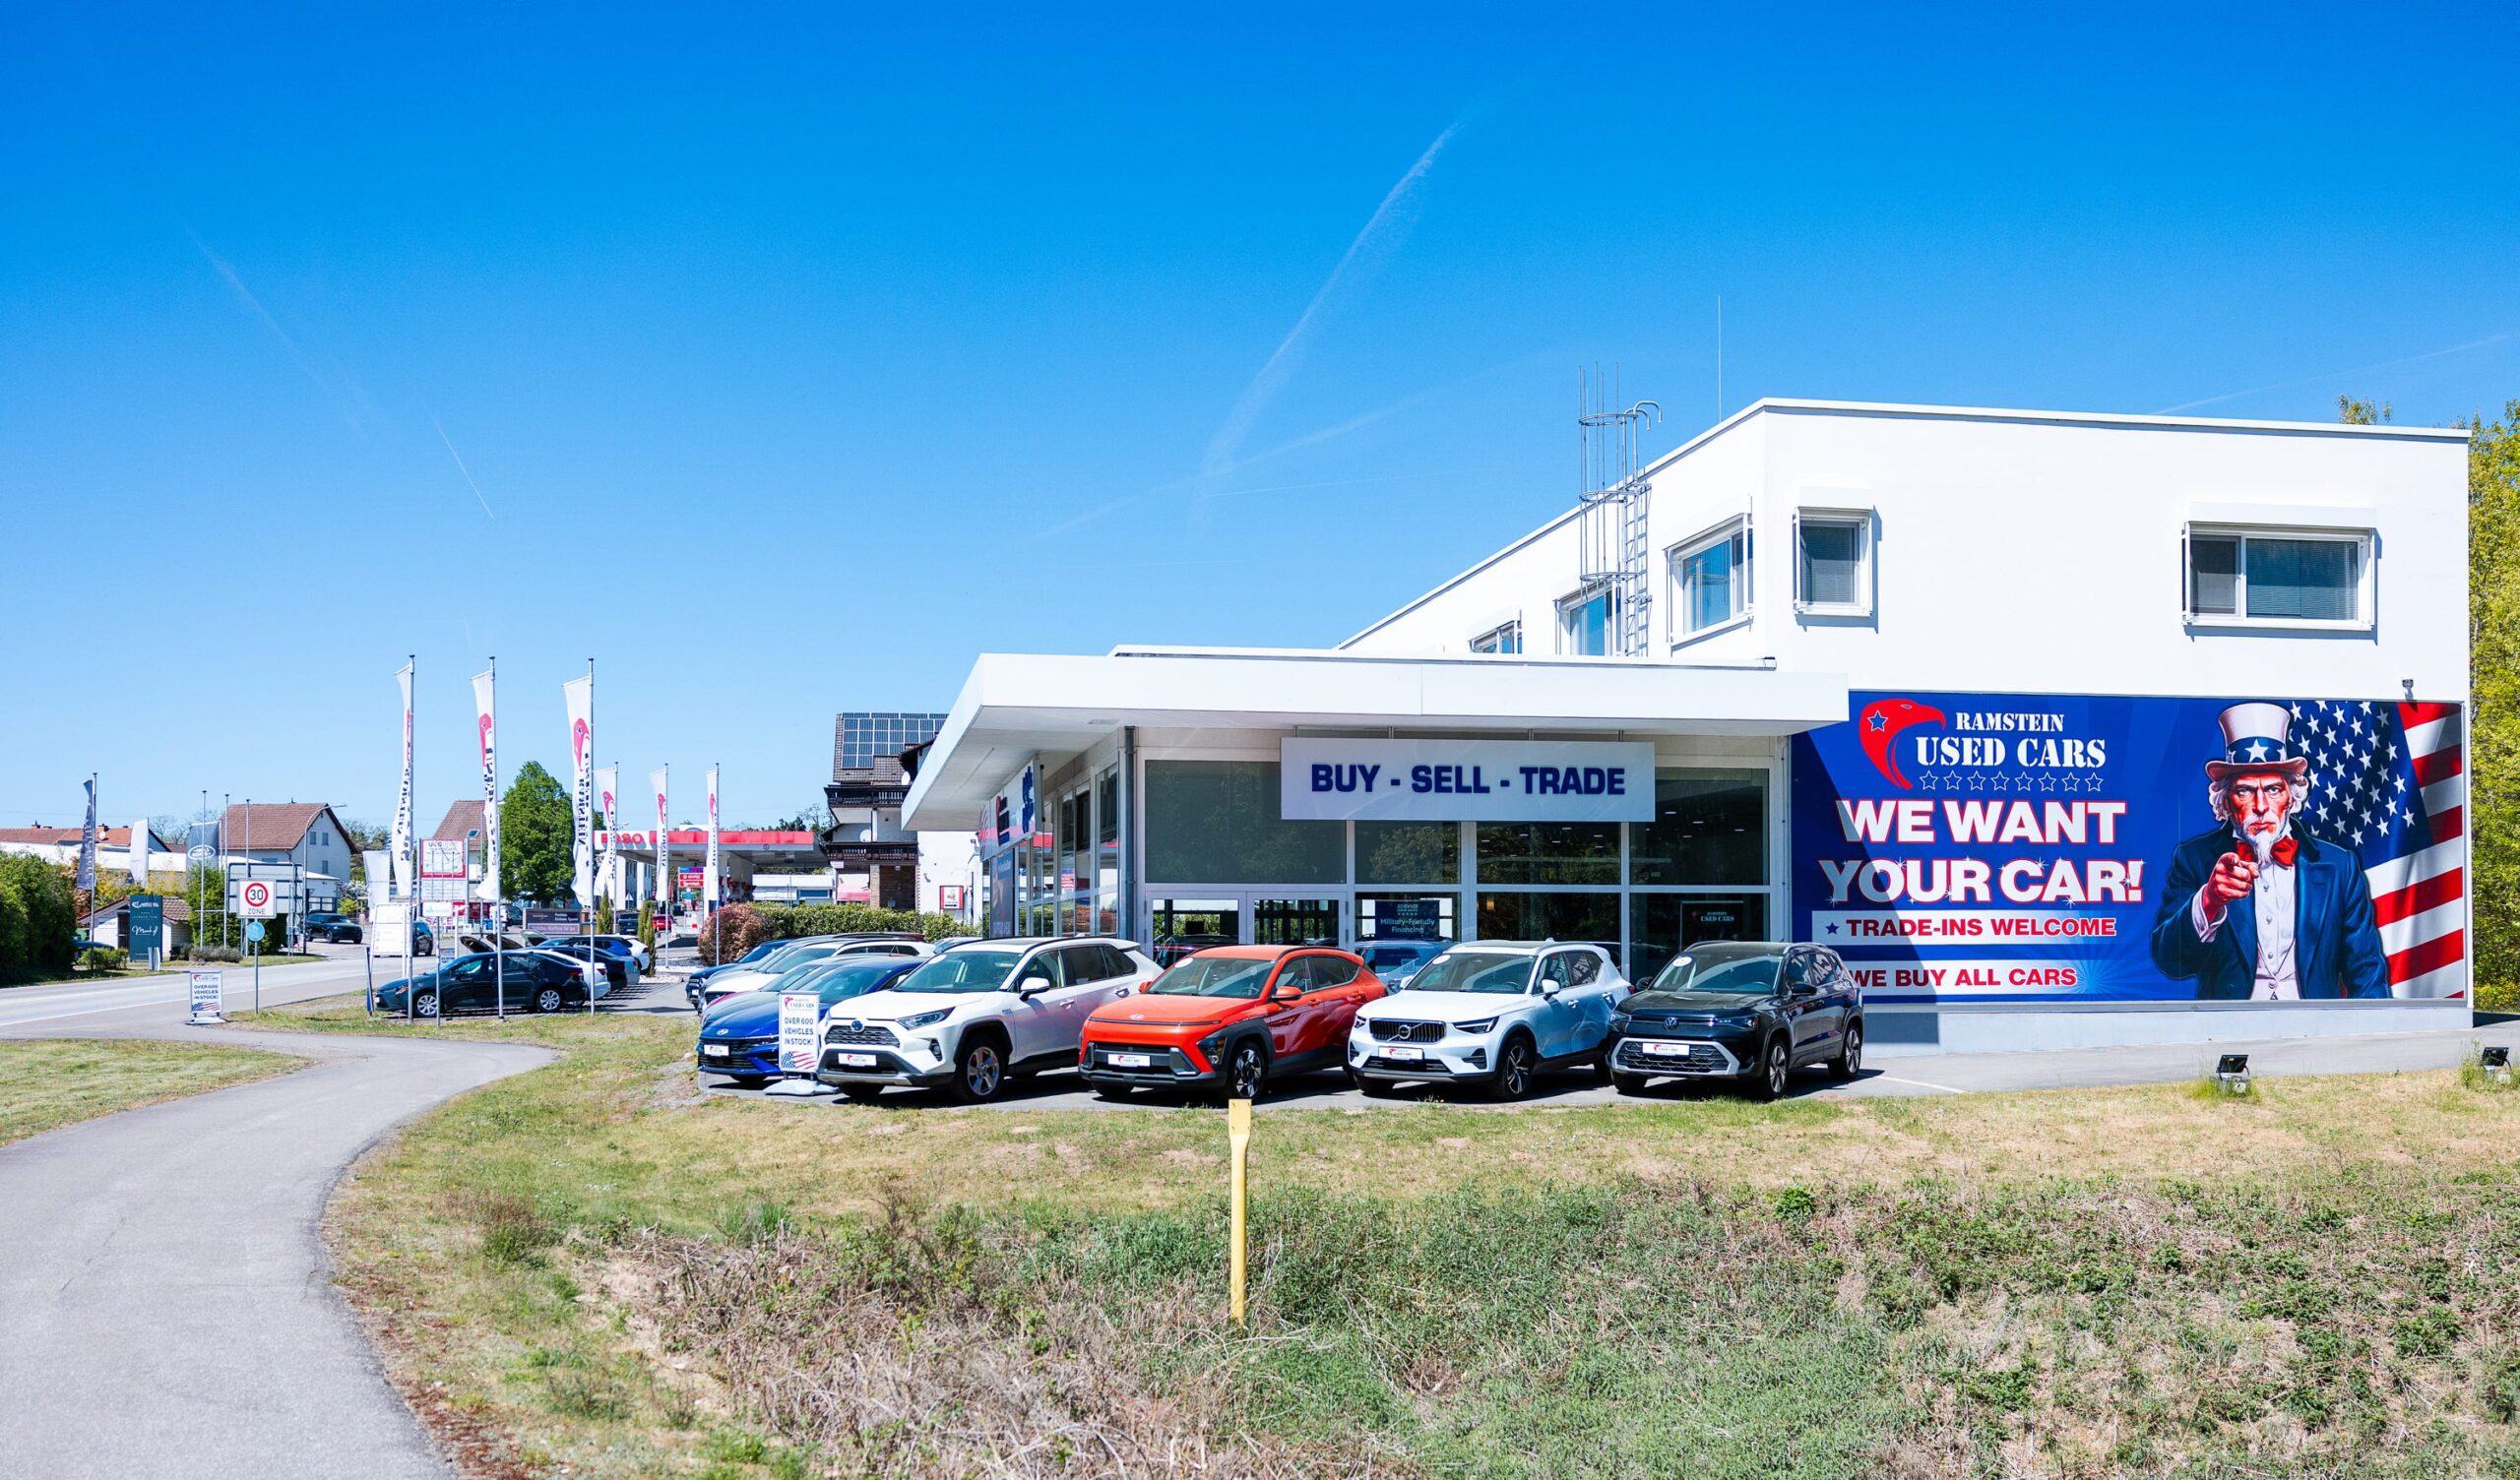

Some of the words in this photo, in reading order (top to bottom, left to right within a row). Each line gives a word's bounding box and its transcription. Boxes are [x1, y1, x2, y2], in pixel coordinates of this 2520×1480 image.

[1955, 711, 2065, 733] RAMSTEIN
[1916, 736, 2006, 767] USED
[2017, 738, 2107, 769] CARS
[1311, 764, 1381, 793] BUY
[1411, 765, 1490, 794] SELL
[1519, 767, 1625, 795] TRADE
[1835, 799, 1936, 843] WE
[1942, 799, 2127, 844] WANT
[1818, 858, 1993, 903] YOUR
[1999, 858, 2144, 903] CAR!
[250, 889, 264, 900] 30
[1846, 918, 1984, 937] TRADE-INS
[1990, 917, 2117, 937] WELCOME
[1849, 969, 1887, 987] WE
[1895, 969, 1947, 987] BUY
[1954, 968, 2001, 986] ALL
[2008, 968, 2078, 986] CARS
